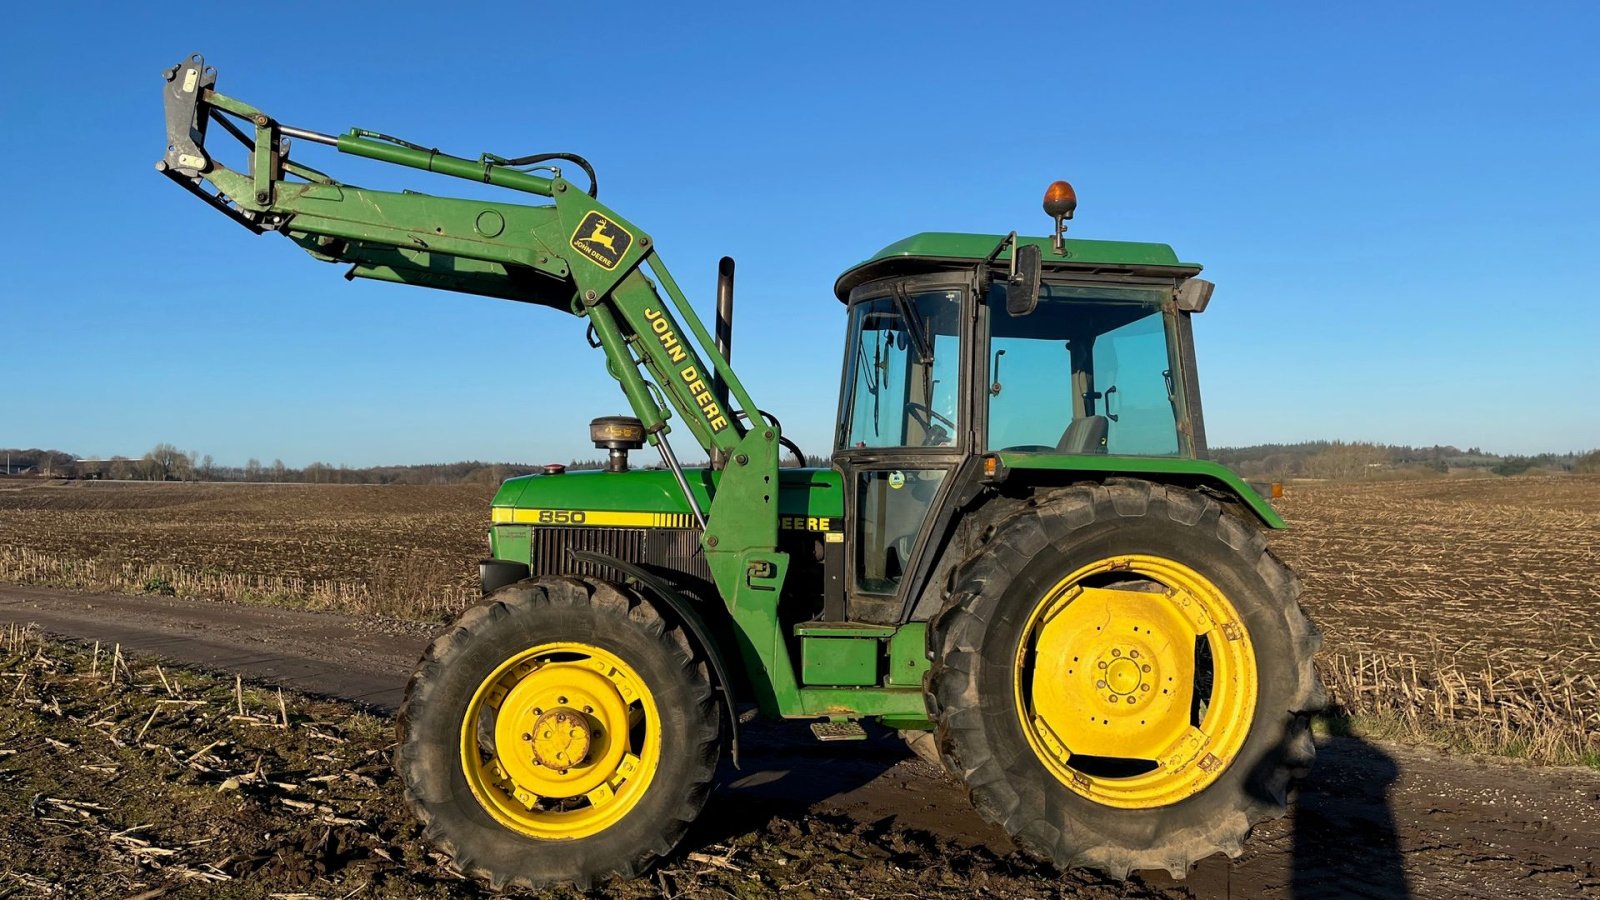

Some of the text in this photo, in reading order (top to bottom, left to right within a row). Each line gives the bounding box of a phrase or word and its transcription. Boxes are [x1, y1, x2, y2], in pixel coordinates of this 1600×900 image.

[573, 240, 612, 267] JOHN DEERE
[644, 307, 728, 432] JOHN DEERE
[538, 510, 586, 524] 850
[778, 517, 830, 531] EERE
